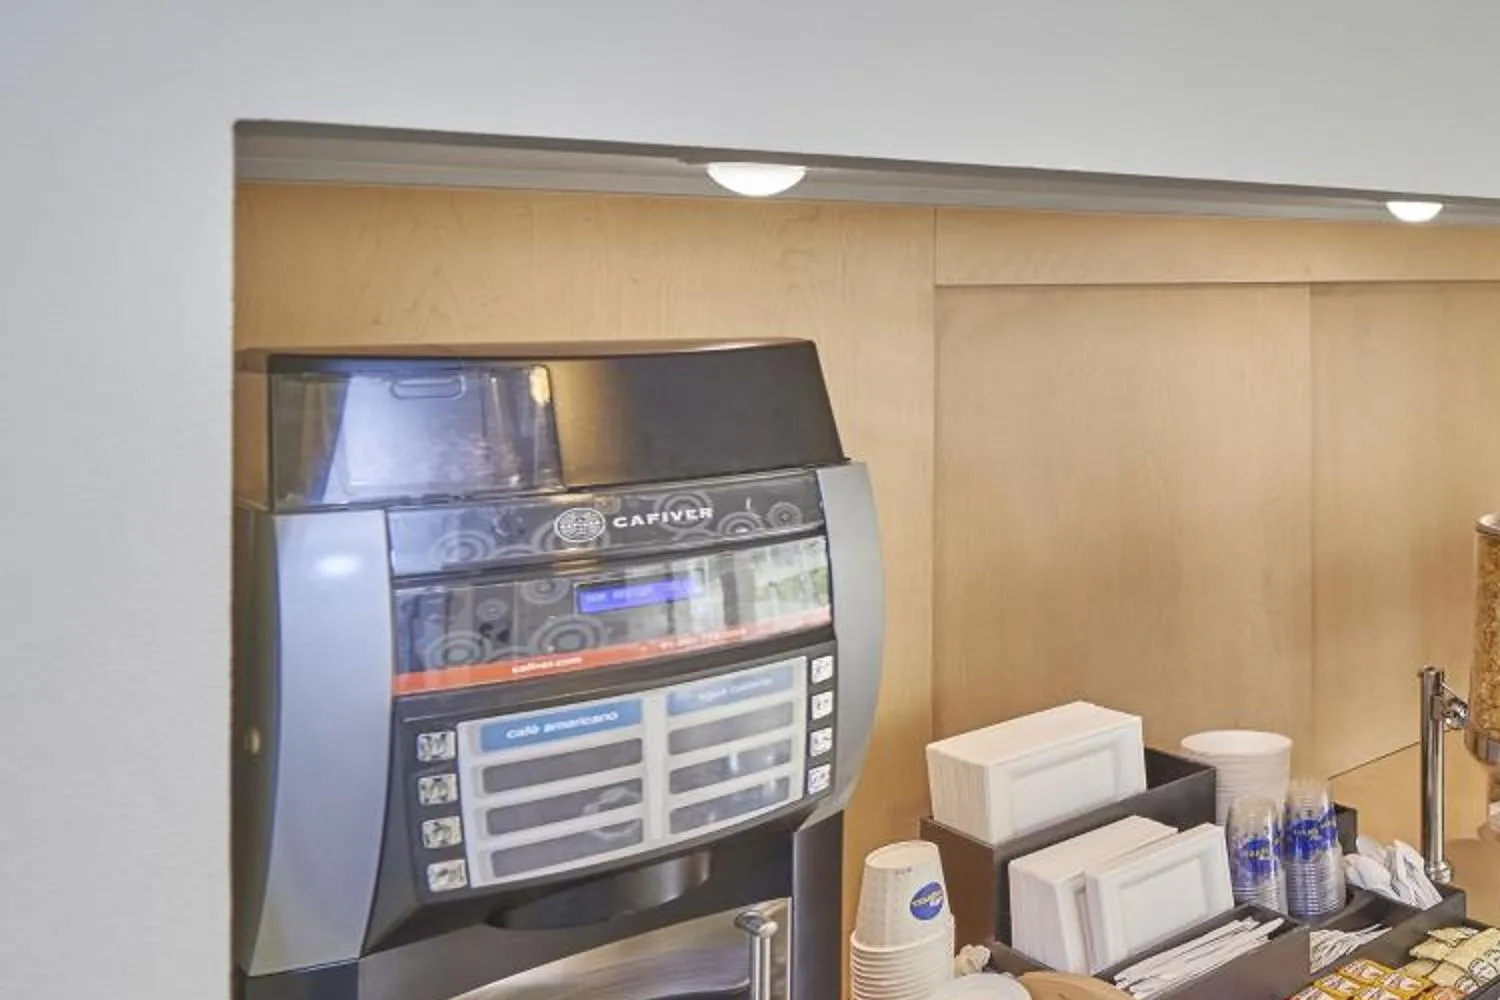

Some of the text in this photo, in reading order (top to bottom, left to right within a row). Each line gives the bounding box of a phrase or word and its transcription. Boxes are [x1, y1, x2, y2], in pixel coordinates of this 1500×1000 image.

[612, 507, 714, 529] CAFIVER
[505, 710, 620, 740] café americano
